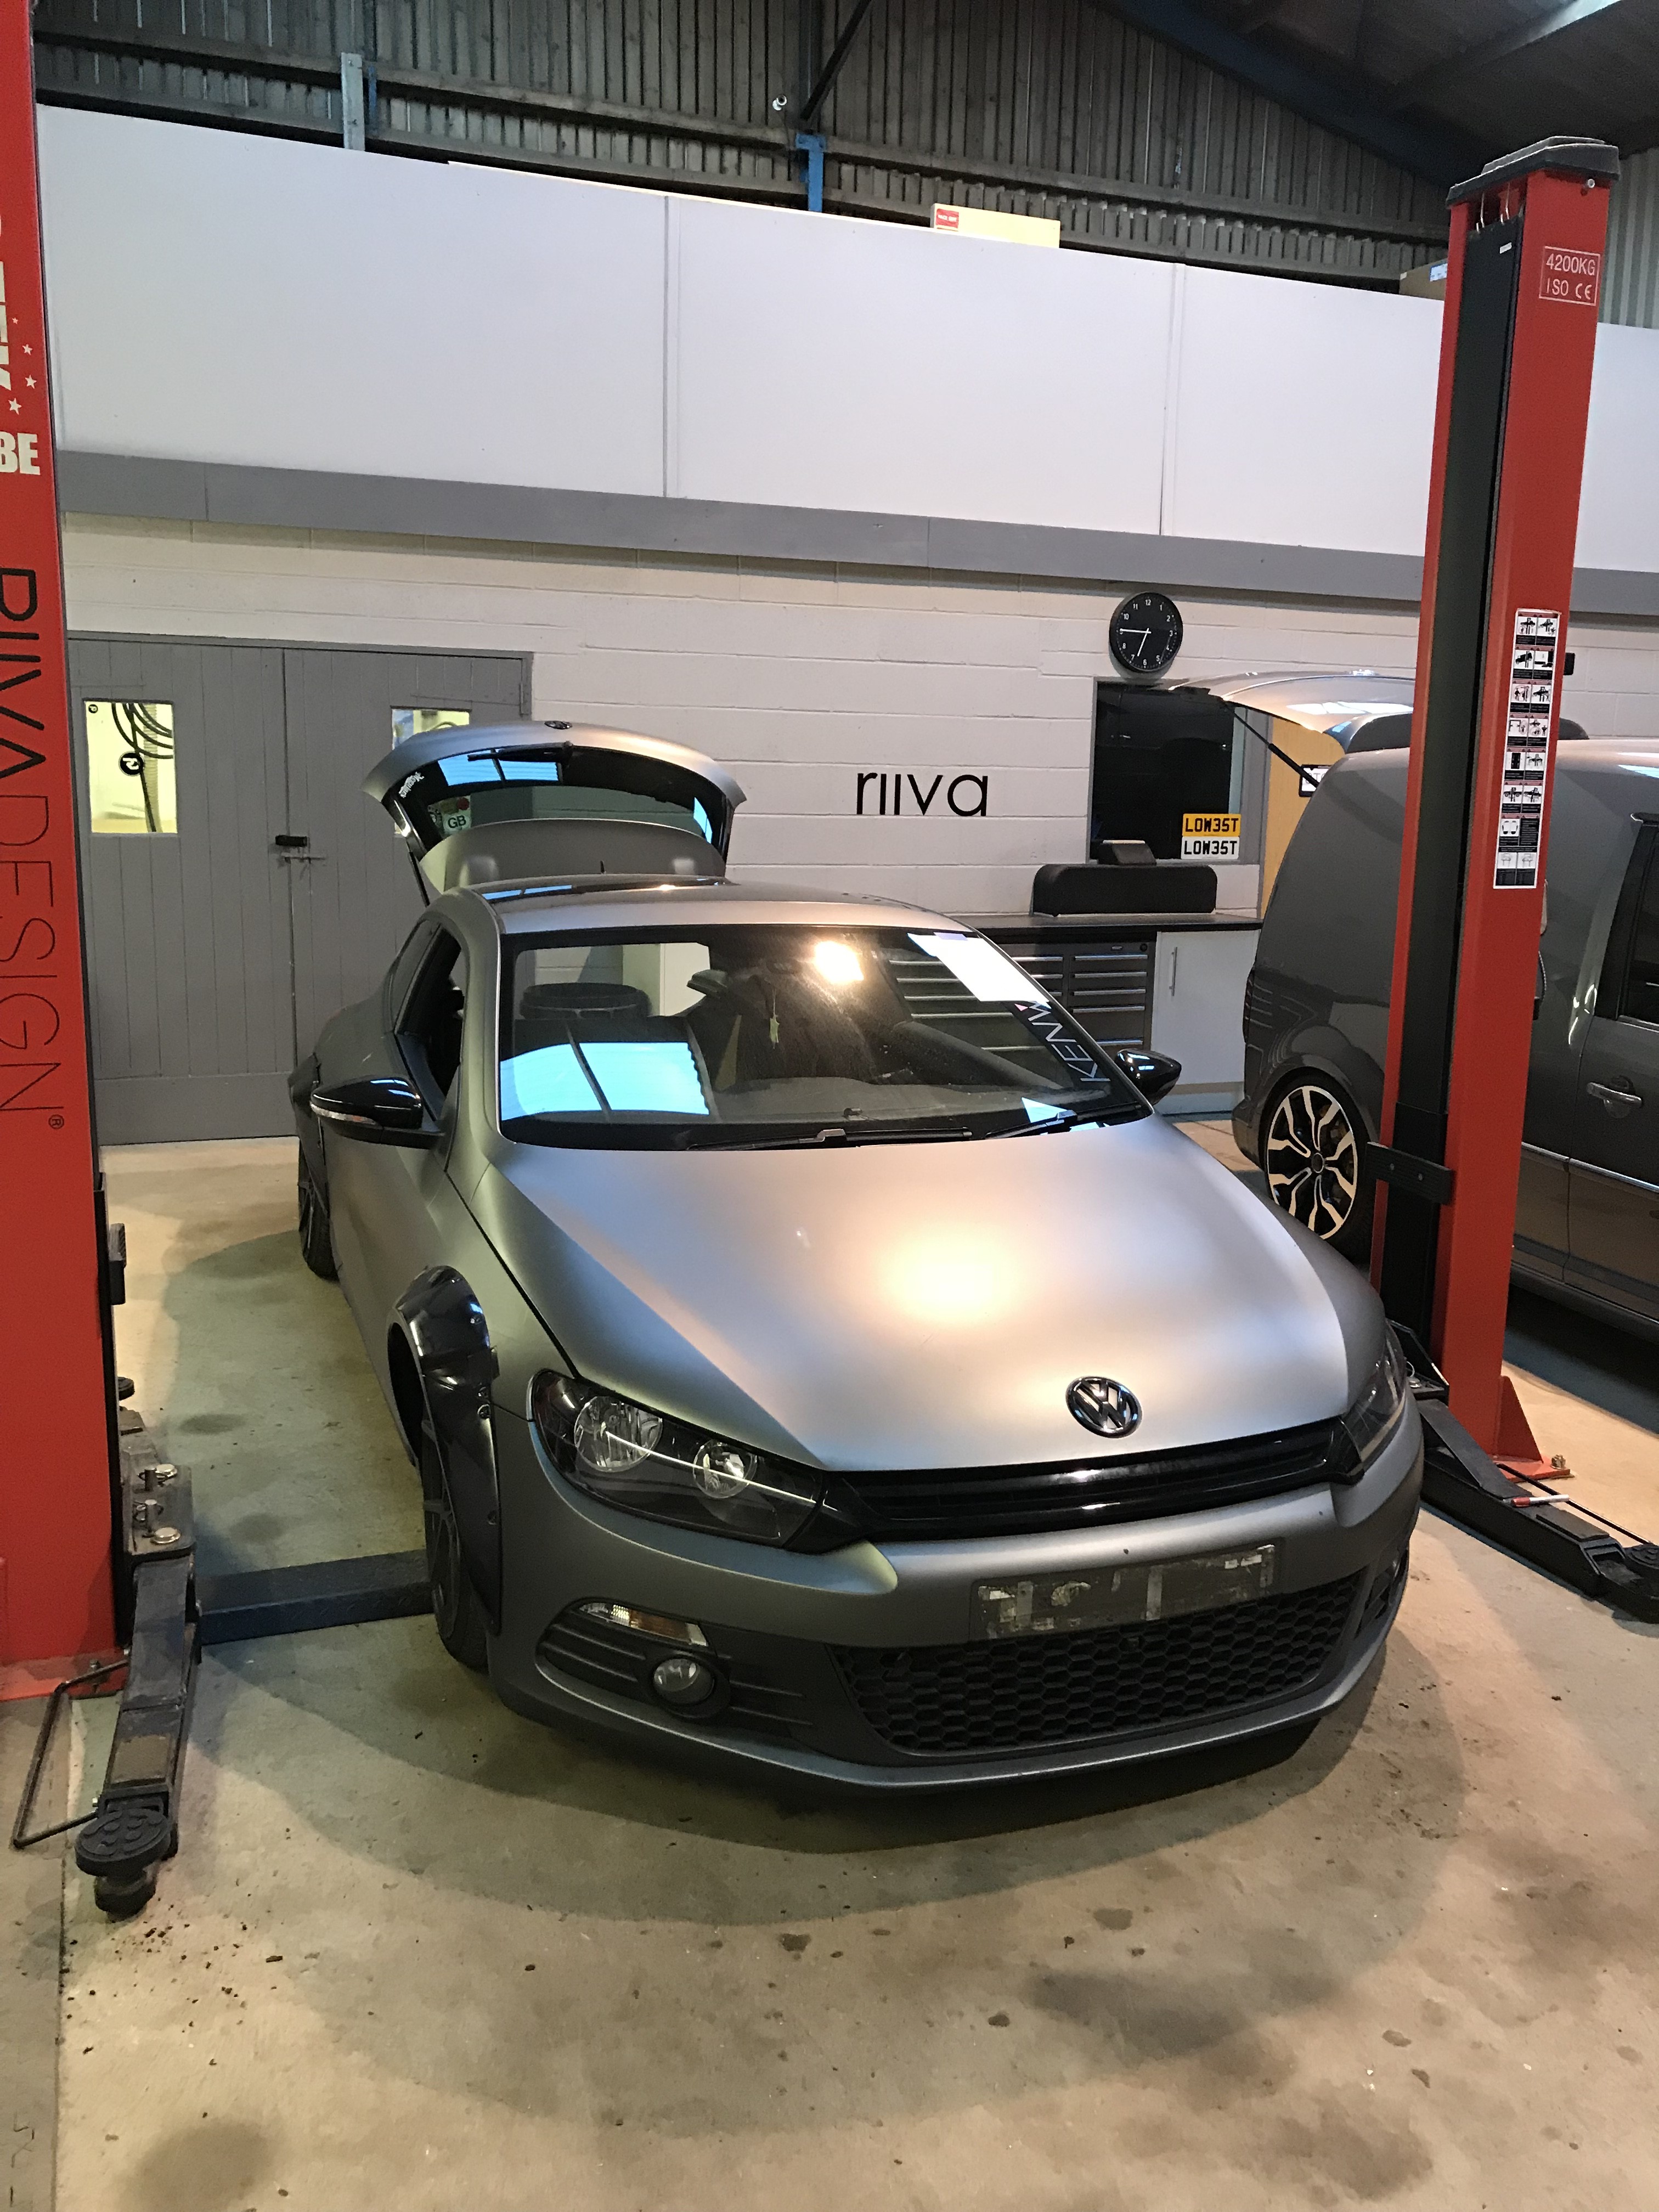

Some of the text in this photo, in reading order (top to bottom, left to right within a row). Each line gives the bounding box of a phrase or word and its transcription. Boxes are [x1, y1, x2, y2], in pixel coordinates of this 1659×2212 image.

[1546, 253, 1595, 275] 4200KG
[1547, 278, 1568, 296] ISO
[856, 772, 988, 816] riiva
[447, 815, 466, 828] GB
